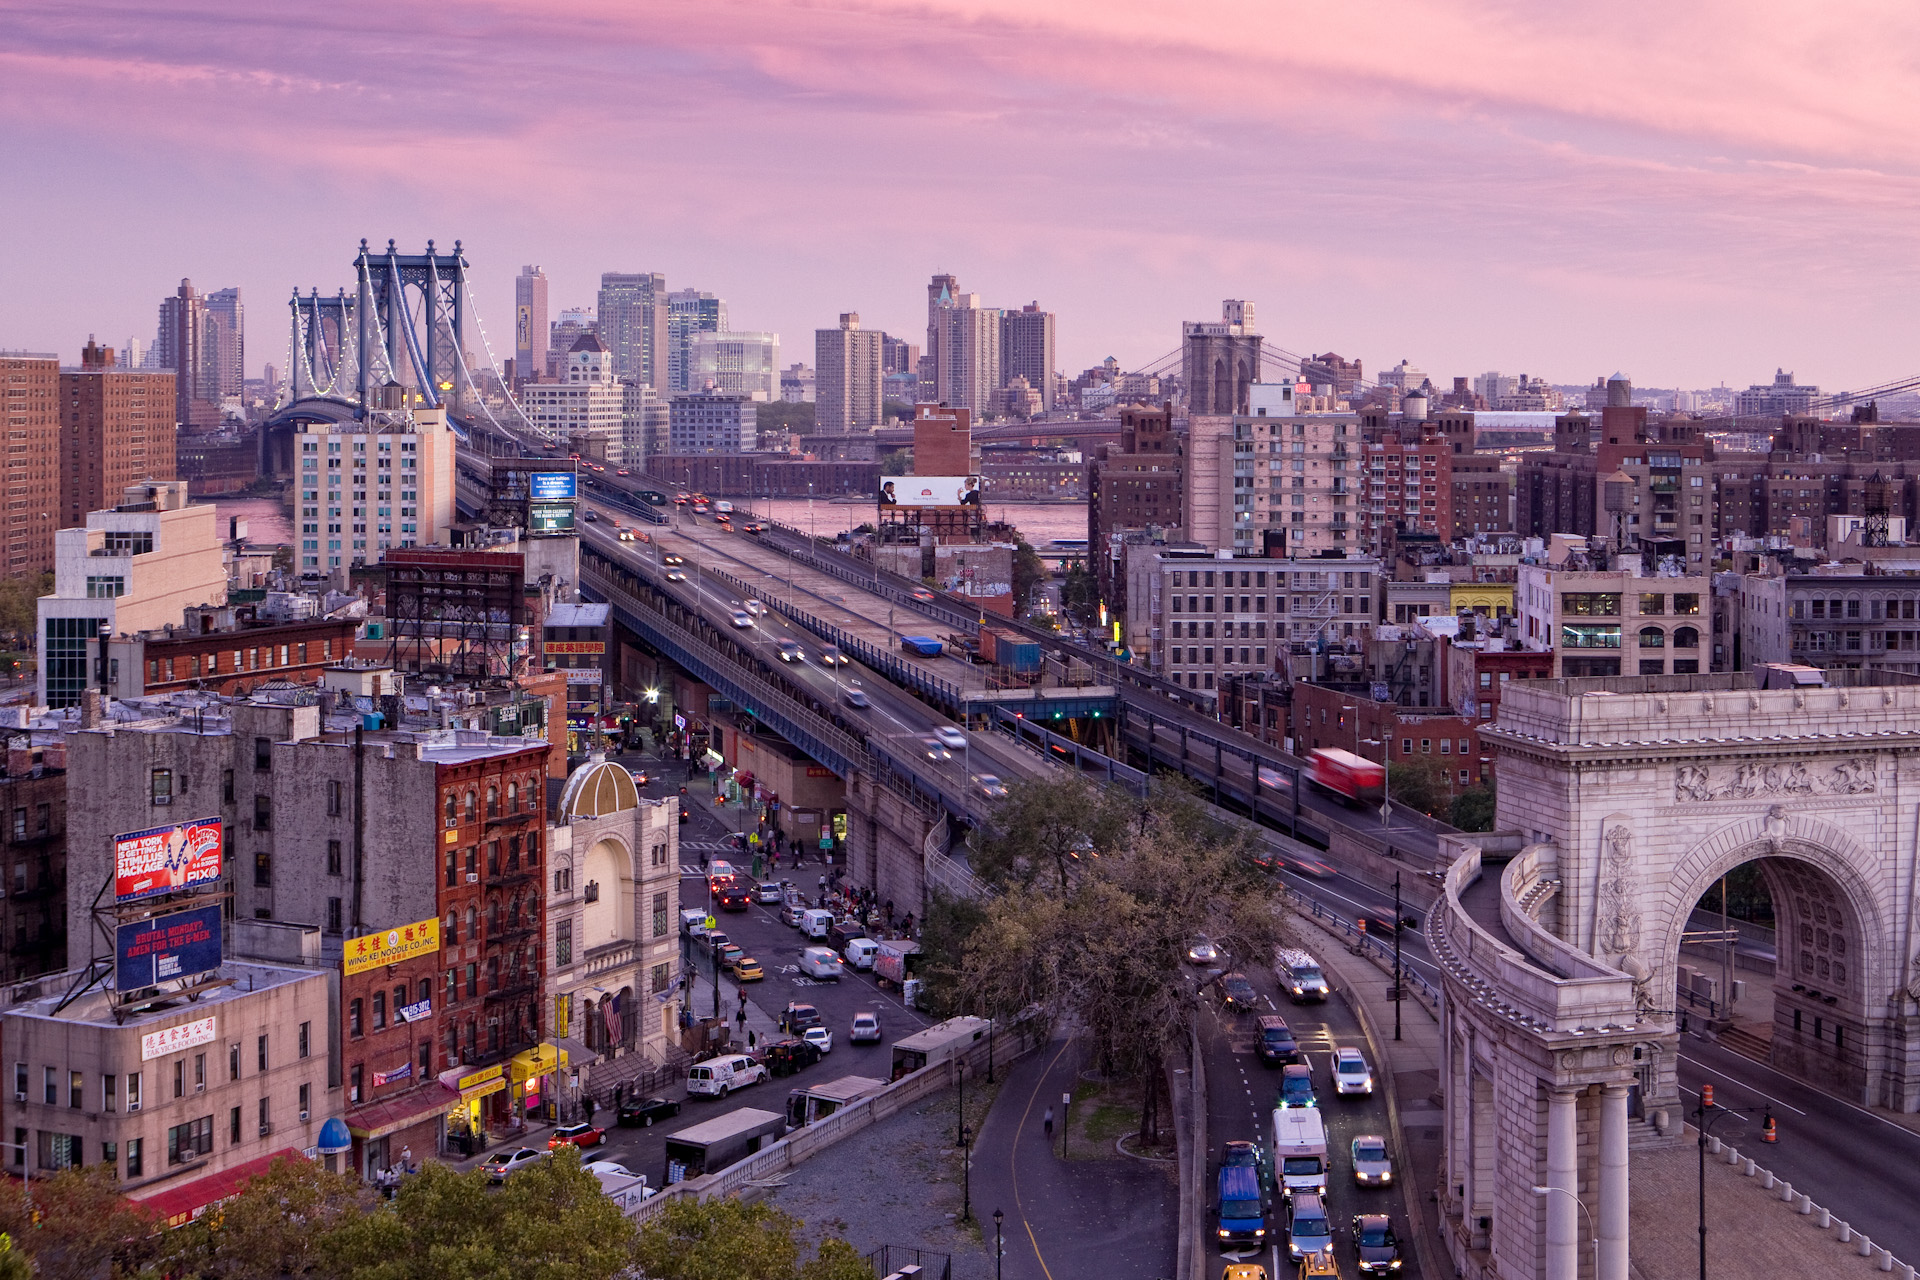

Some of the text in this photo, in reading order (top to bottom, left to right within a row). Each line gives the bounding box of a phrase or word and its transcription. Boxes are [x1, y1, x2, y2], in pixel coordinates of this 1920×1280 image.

[545, 643, 604, 653] 速成英語學院
[117, 836, 163, 852] NEW YORK
[118, 851, 125, 859] IS
[126, 847, 157, 857] GETTING
[117, 852, 163, 869] STIMULUS
[117, 861, 163, 879] PACKAGE
[136, 920, 203, 945] BRUTAL MONDAY?
[127, 943, 150, 958] AMEN
[152, 940, 167, 952] FOR
[169, 936, 184, 948] THE
[347, 955, 368, 967] WING
[369, 952, 380, 961] KEI
[380, 944, 408, 958] NOODLE
[145, 1018, 213, 1049] 德益食品公司
[146, 1048, 160, 1057] TAK
[160, 1043, 177, 1054] YICK
[178, 1038, 197, 1048] FOOD
